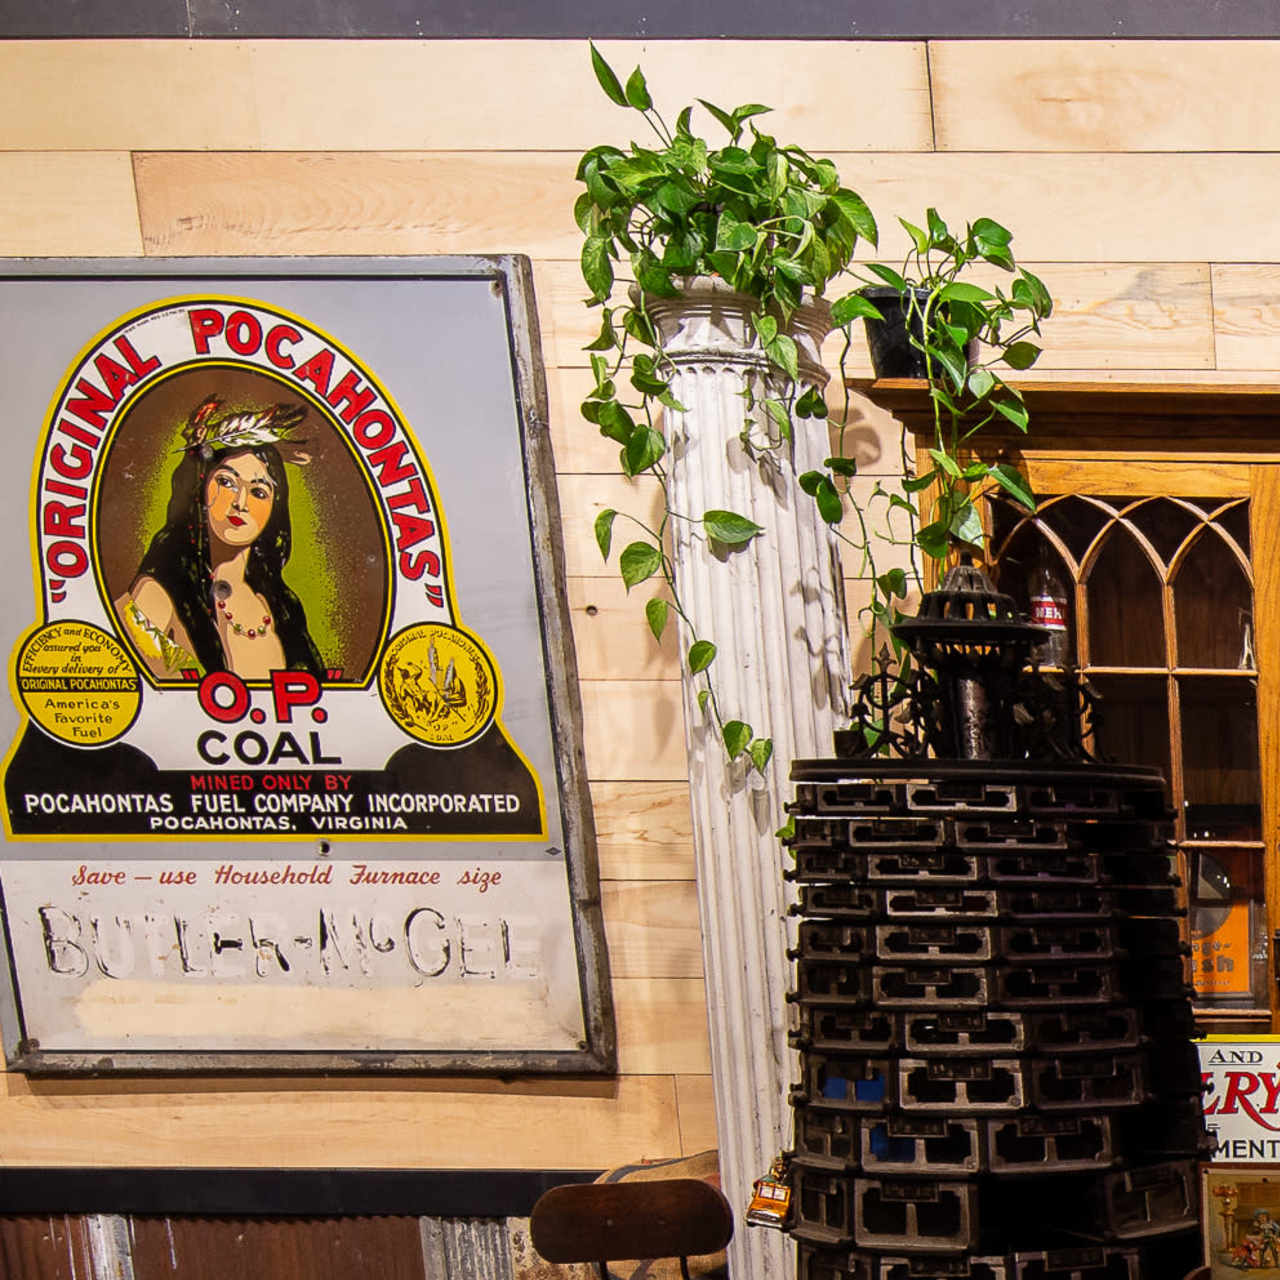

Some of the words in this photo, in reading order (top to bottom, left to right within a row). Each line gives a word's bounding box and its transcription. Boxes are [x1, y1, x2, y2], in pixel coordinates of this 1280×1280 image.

[22, 627, 62, 672] EFFICIENCY
[63, 627, 82, 636] and
[83, 628, 132, 673] ECONOMY
[43, 642, 82, 652] assured
[82, 644, 101, 654] you
[70, 653, 82, 662] in
[33, 666, 59, 674] every
[61, 663, 104, 675] delivery
[107, 664, 120, 674] of
[22, 679, 68, 690] ORIGINAL
[71, 679, 137, 691] POCAHONTAS
[45, 698, 120, 709] America's
[55, 712, 112, 724] Favorite
[73, 727, 101, 737] Fuel
[196, 730, 342, 765] COAL
[191, 775, 255, 790] MINED
[262, 775, 318, 790] ONLY
[325, 775, 353, 790] BY
[25, 793, 174, 814] POCAHONTAS
[192, 793, 246, 814] FUEL
[254, 793, 352, 814] COMPANY
[368, 793, 521, 814] INCORPORATED
[150, 816, 298, 833] POCAHONTAS,
[311, 816, 408, 832] VIRGINIA
[71, 864, 126, 887] Save
[160, 868, 197, 886] use
[214, 864, 333, 887] Household
[349, 865, 440, 887] Furnace
[457, 865, 502, 893] size
[1208, 1049, 1263, 1064] AND
